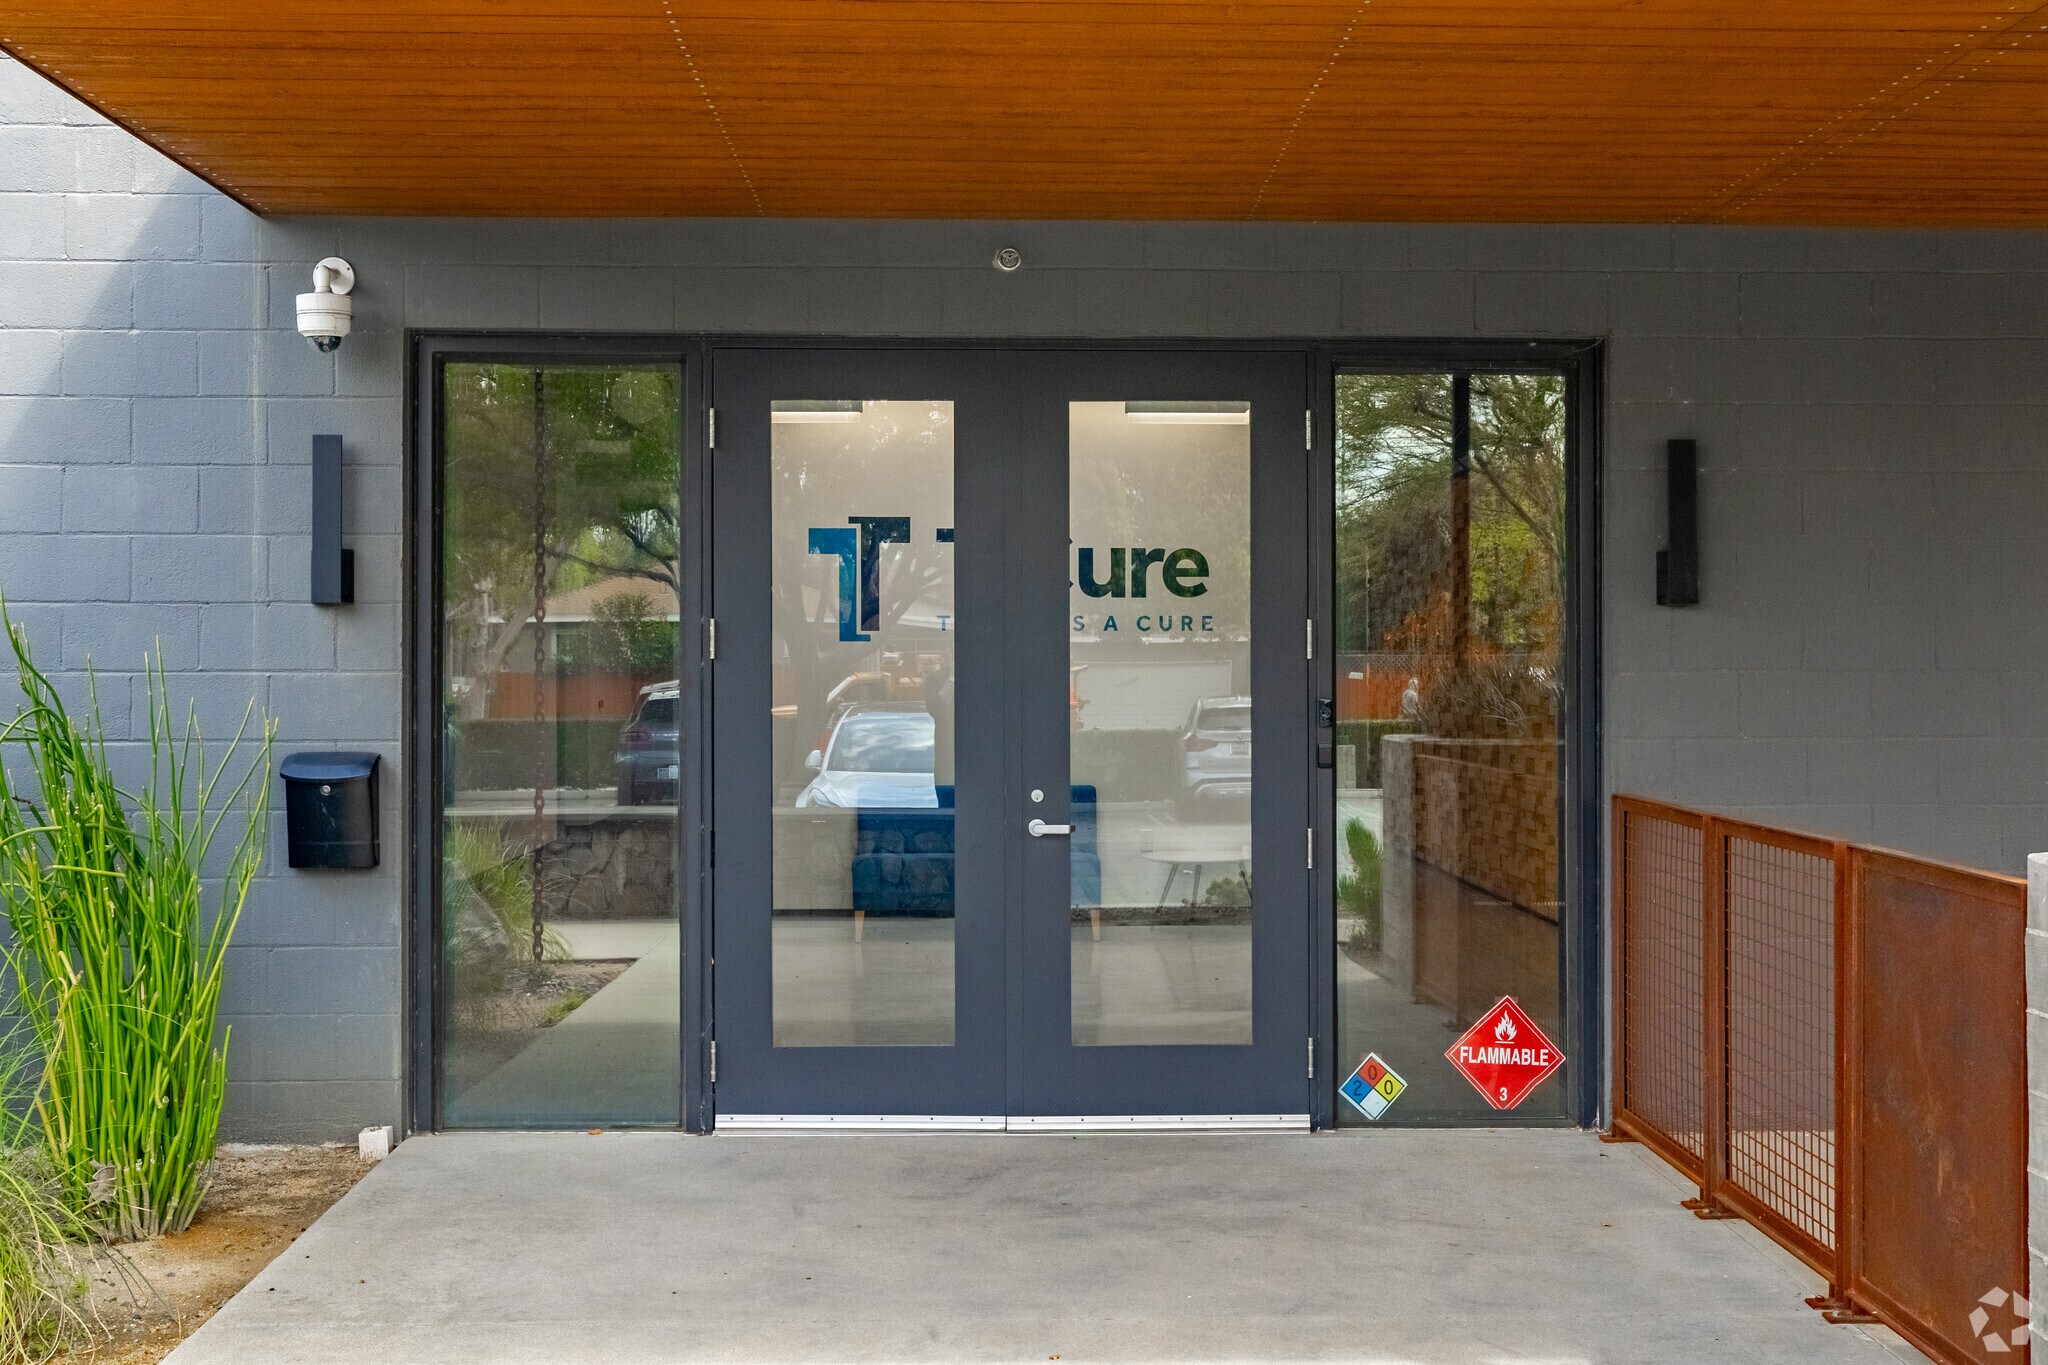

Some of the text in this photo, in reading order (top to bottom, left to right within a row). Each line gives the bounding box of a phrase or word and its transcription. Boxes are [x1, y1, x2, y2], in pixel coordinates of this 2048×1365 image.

[1069, 537, 1210, 598] ure
[1103, 615, 1119, 632] A
[1136, 615, 1214, 632] CURE
[1460, 1046, 1549, 1066] FLAMMABLE
[1367, 1065, 1378, 1080] 0
[1353, 1079, 1394, 1096] 2 0
[1499, 1087, 1508, 1102] 3
